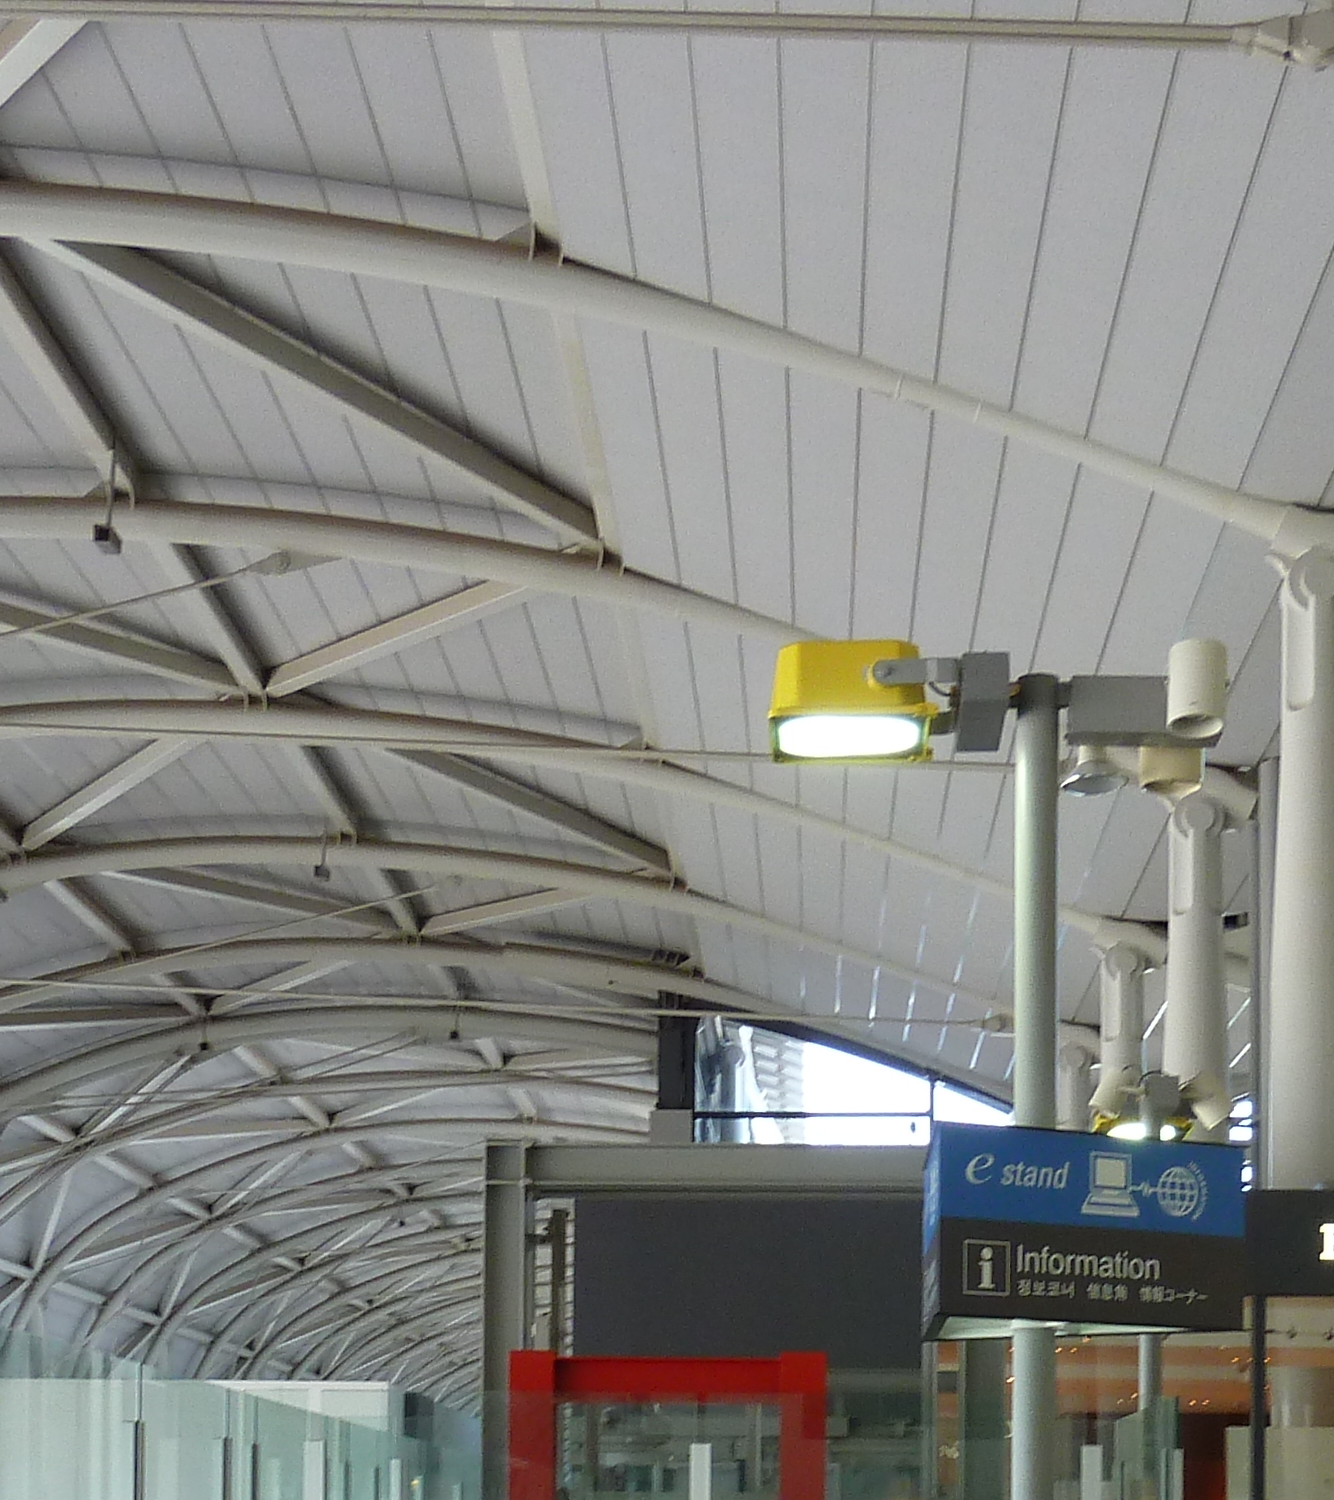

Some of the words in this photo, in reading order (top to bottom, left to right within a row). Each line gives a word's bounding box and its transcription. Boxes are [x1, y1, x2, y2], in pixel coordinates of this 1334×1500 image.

[965, 1153, 995, 1184] e
[1000, 1161, 1071, 1189] stand
[1017, 1244, 1161, 1281] Information
